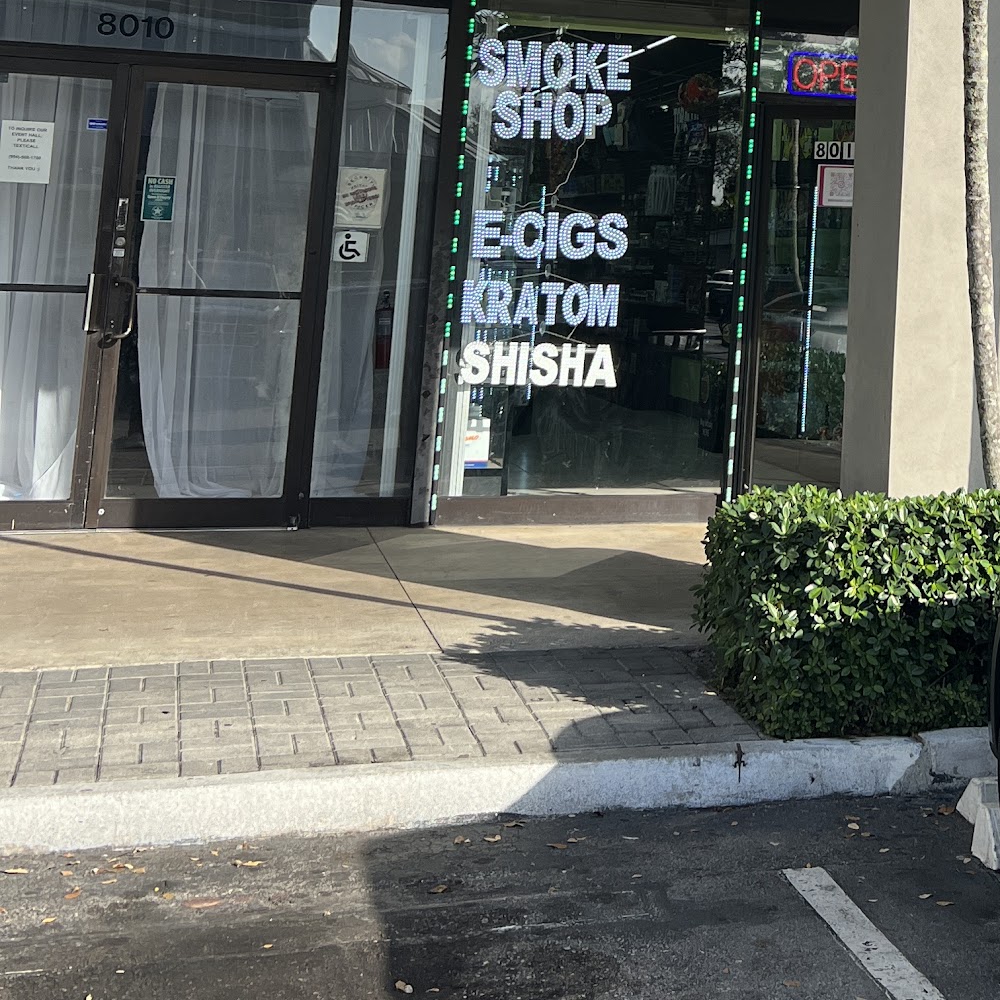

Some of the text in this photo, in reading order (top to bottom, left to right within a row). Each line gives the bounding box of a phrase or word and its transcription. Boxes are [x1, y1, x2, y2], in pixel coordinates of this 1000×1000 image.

[97, 12, 175, 39] 8010
[477, 38, 632, 92] SMOKE
[793, 58, 858, 92] OPE
[492, 90, 613, 140] SHOP
[157, 178, 174, 186] CASH
[472, 209, 629, 260] E-CIGS
[460, 278, 621, 328] KRATOM
[458, 341, 618, 388] SHISHA
